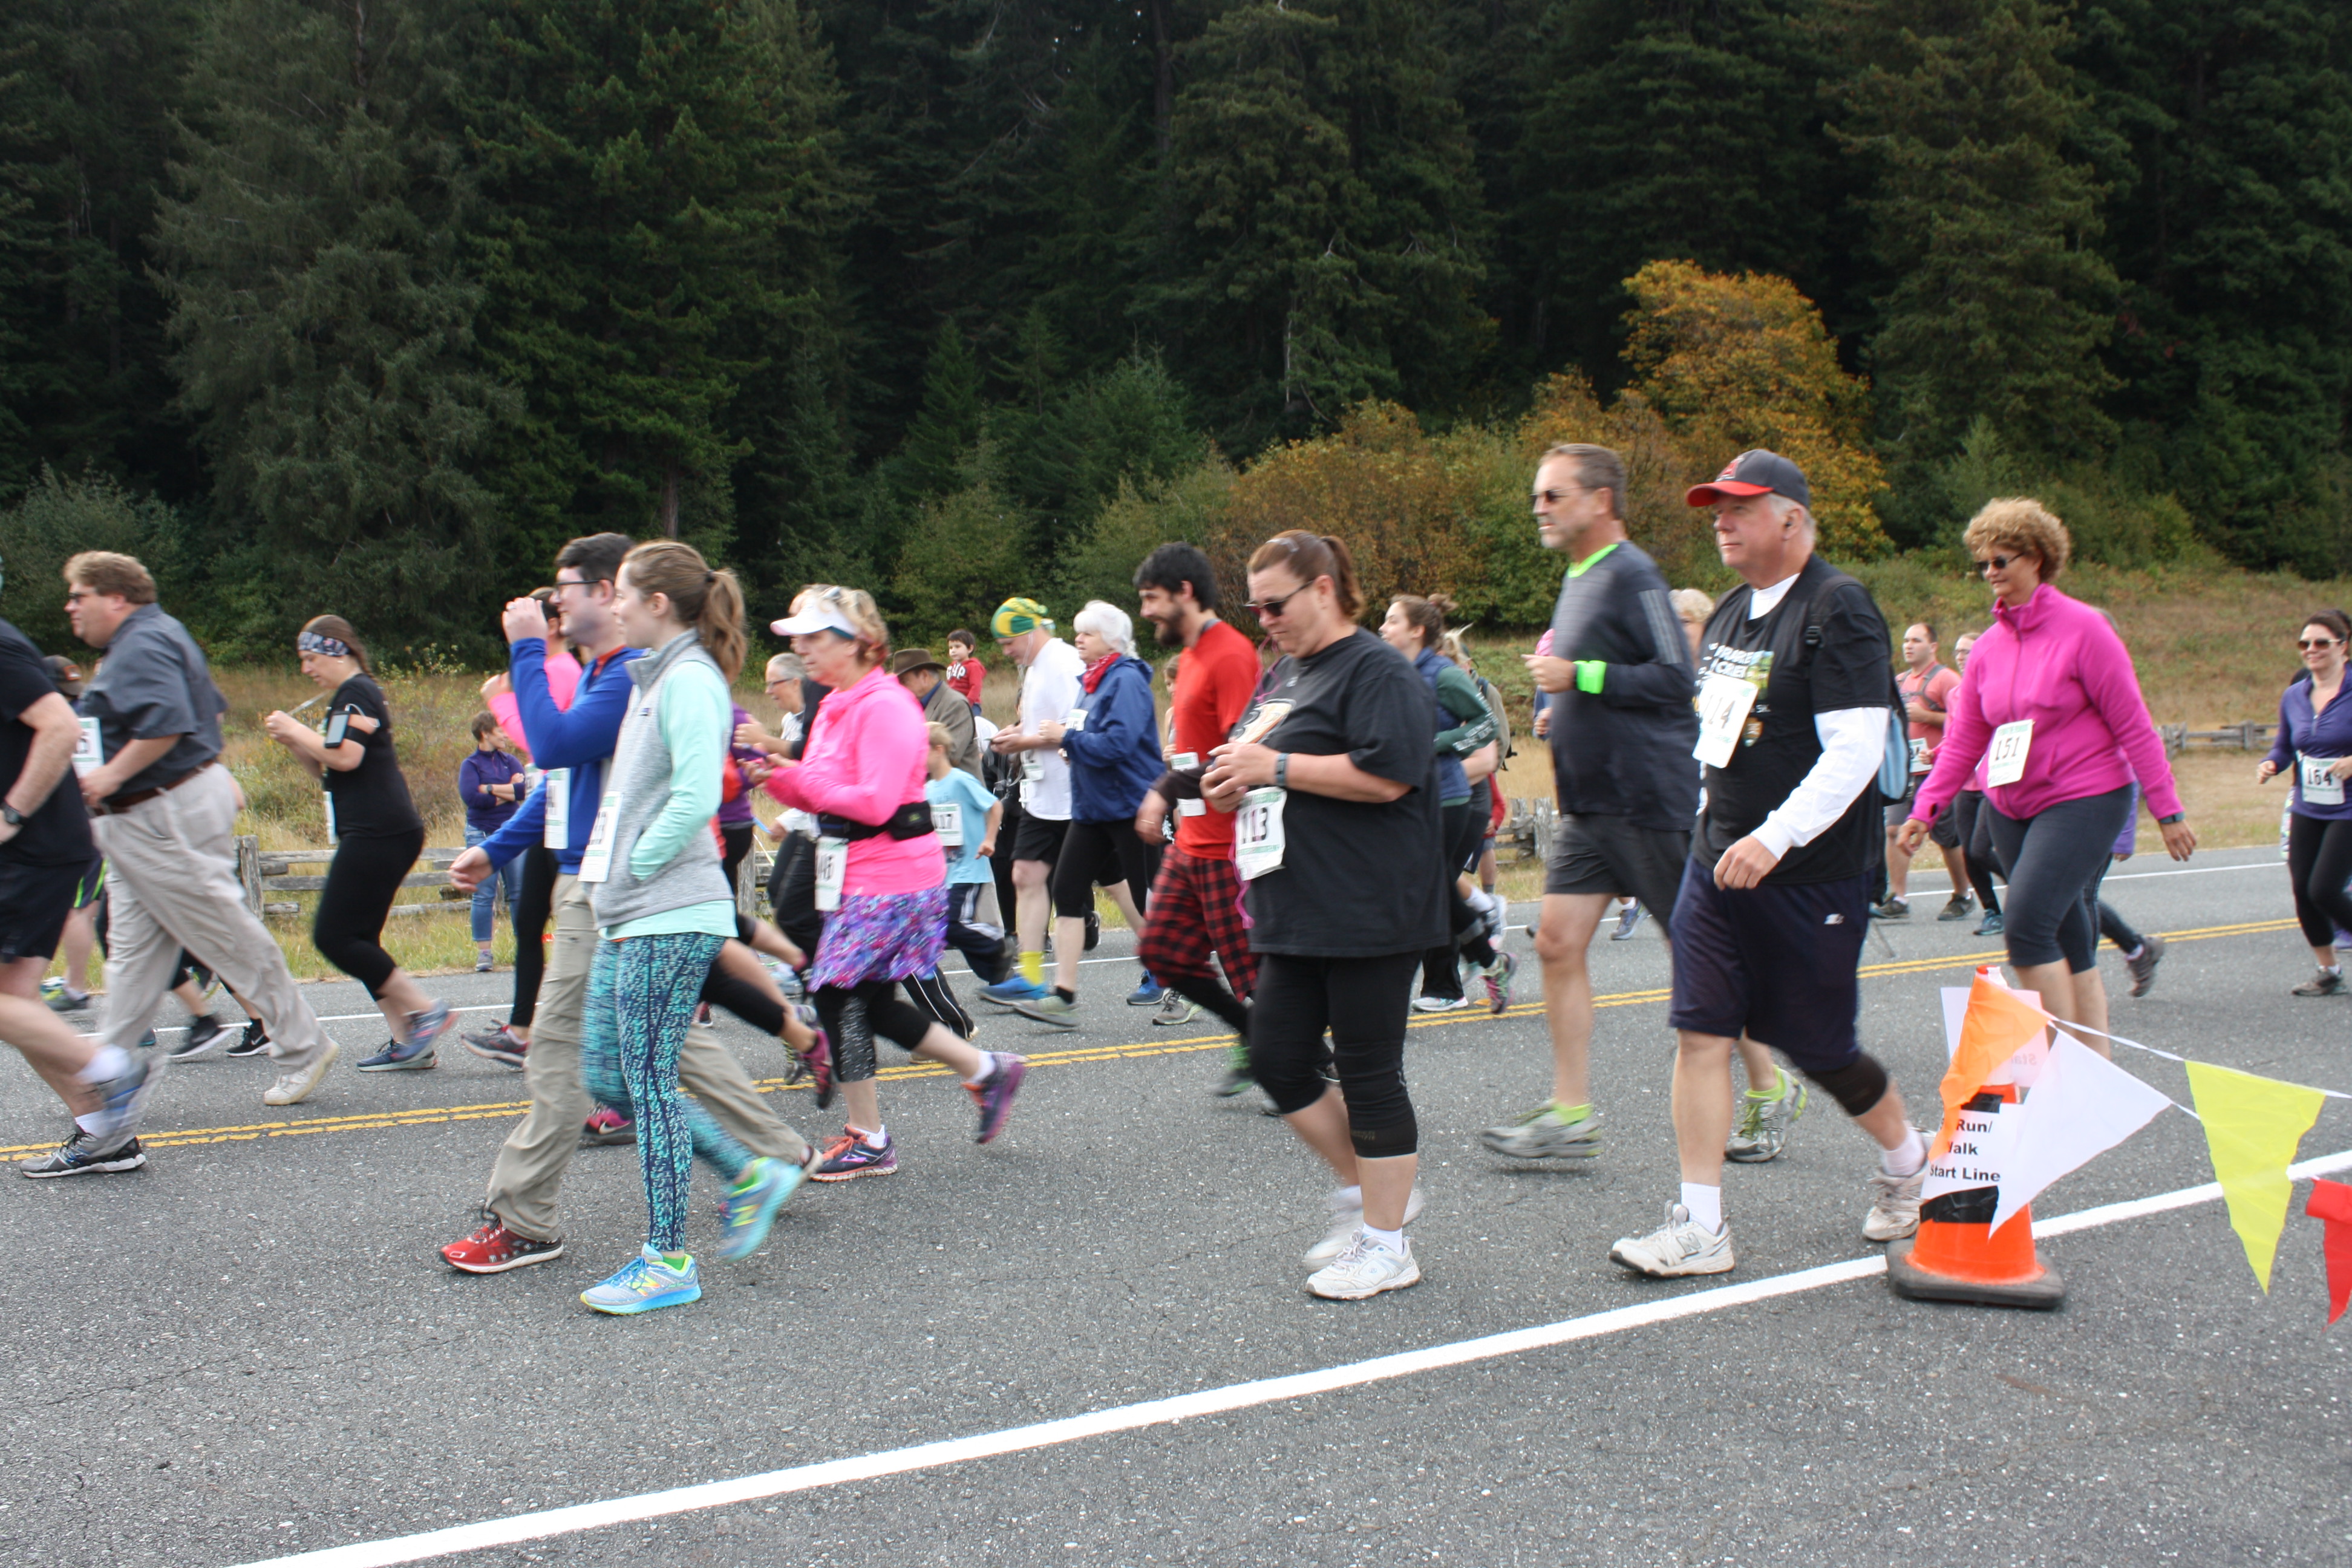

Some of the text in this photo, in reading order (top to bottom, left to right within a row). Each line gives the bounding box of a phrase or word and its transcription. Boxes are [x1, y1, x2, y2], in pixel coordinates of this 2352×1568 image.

[1994, 736, 2020, 760] 151
[2307, 768, 2333, 786] 164
[1956, 1119, 1993, 1133] Run/
[1929, 1163, 2001, 1181] Start Line
